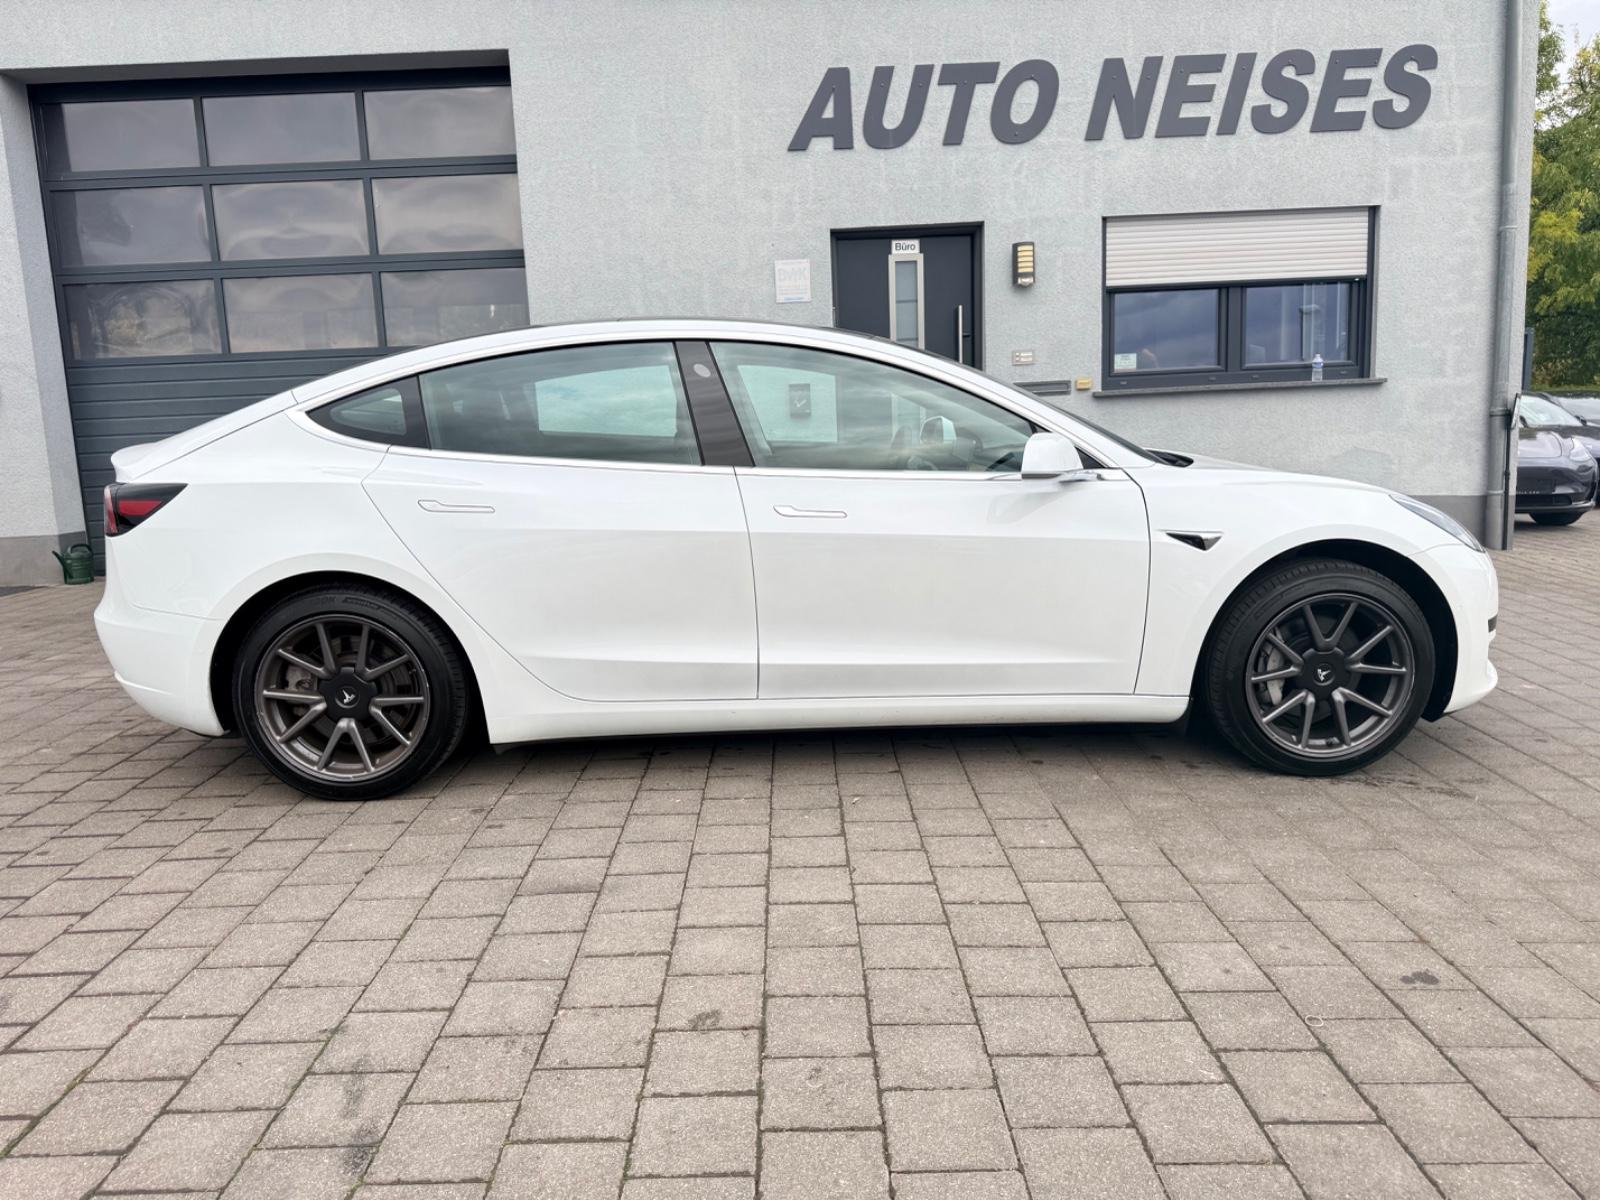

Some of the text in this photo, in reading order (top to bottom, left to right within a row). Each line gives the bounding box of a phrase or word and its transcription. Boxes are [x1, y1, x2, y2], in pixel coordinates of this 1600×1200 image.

[788, 45, 1438, 152] AUTO NEISES
[895, 241, 916, 251] Büro
